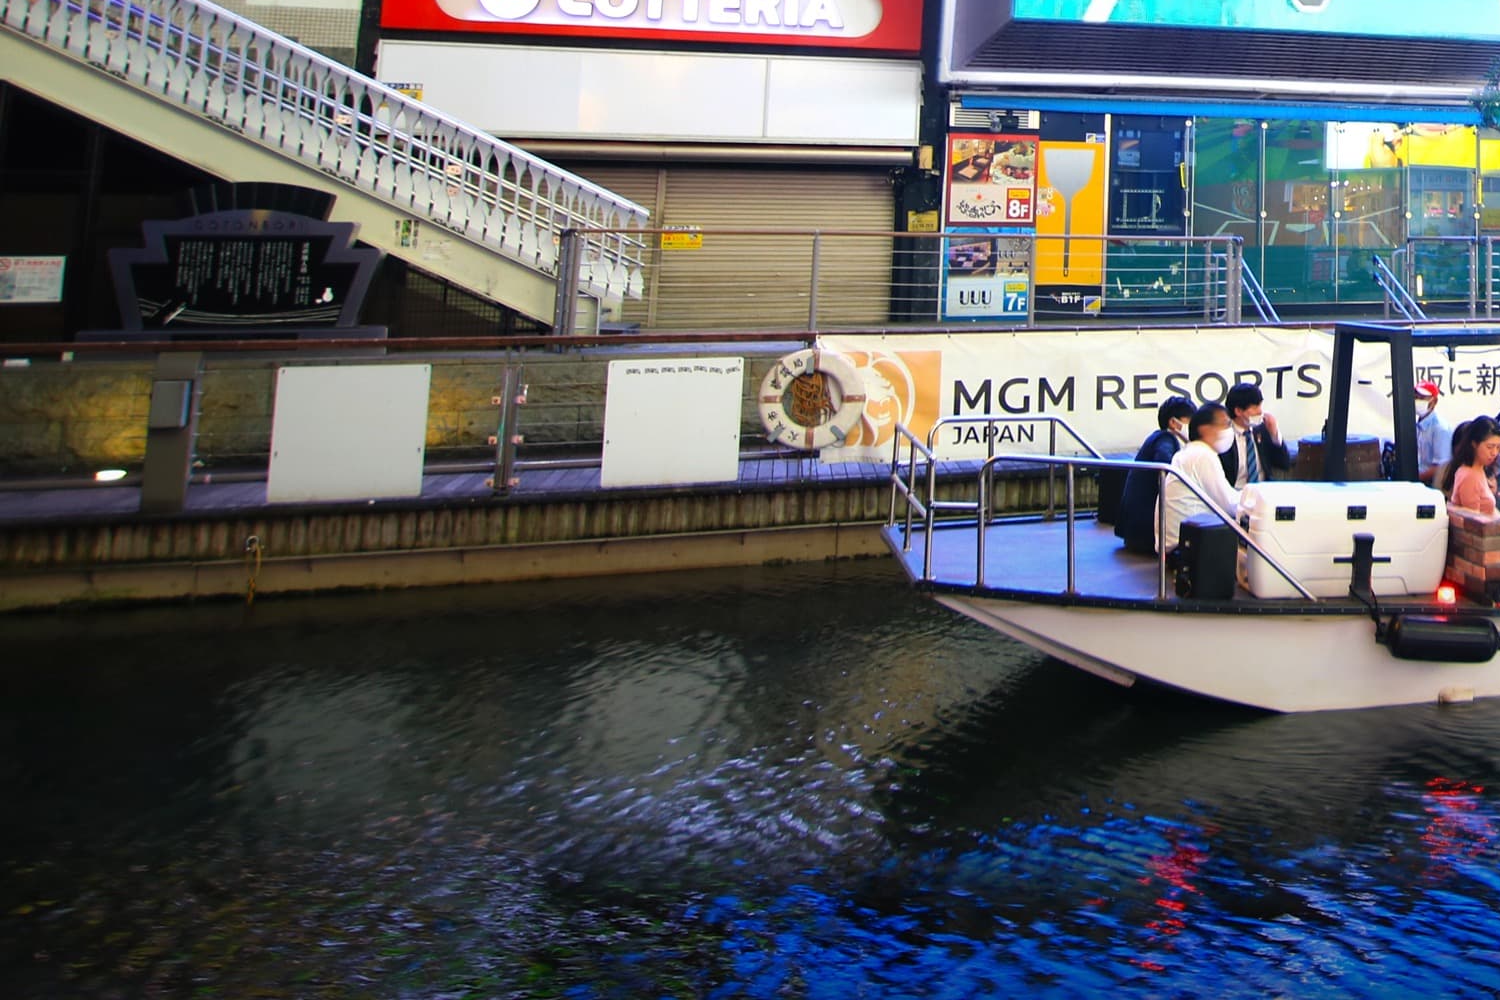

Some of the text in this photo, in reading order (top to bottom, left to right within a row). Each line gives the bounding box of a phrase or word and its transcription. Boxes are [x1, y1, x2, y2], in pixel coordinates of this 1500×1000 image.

[1008, 200, 1029, 218] 8F
[959, 290, 992, 305] UUU
[1006, 294, 1026, 311] 7F
[953, 363, 1323, 416] MGM RESORTS
[953, 423, 1036, 448] JAPAN
